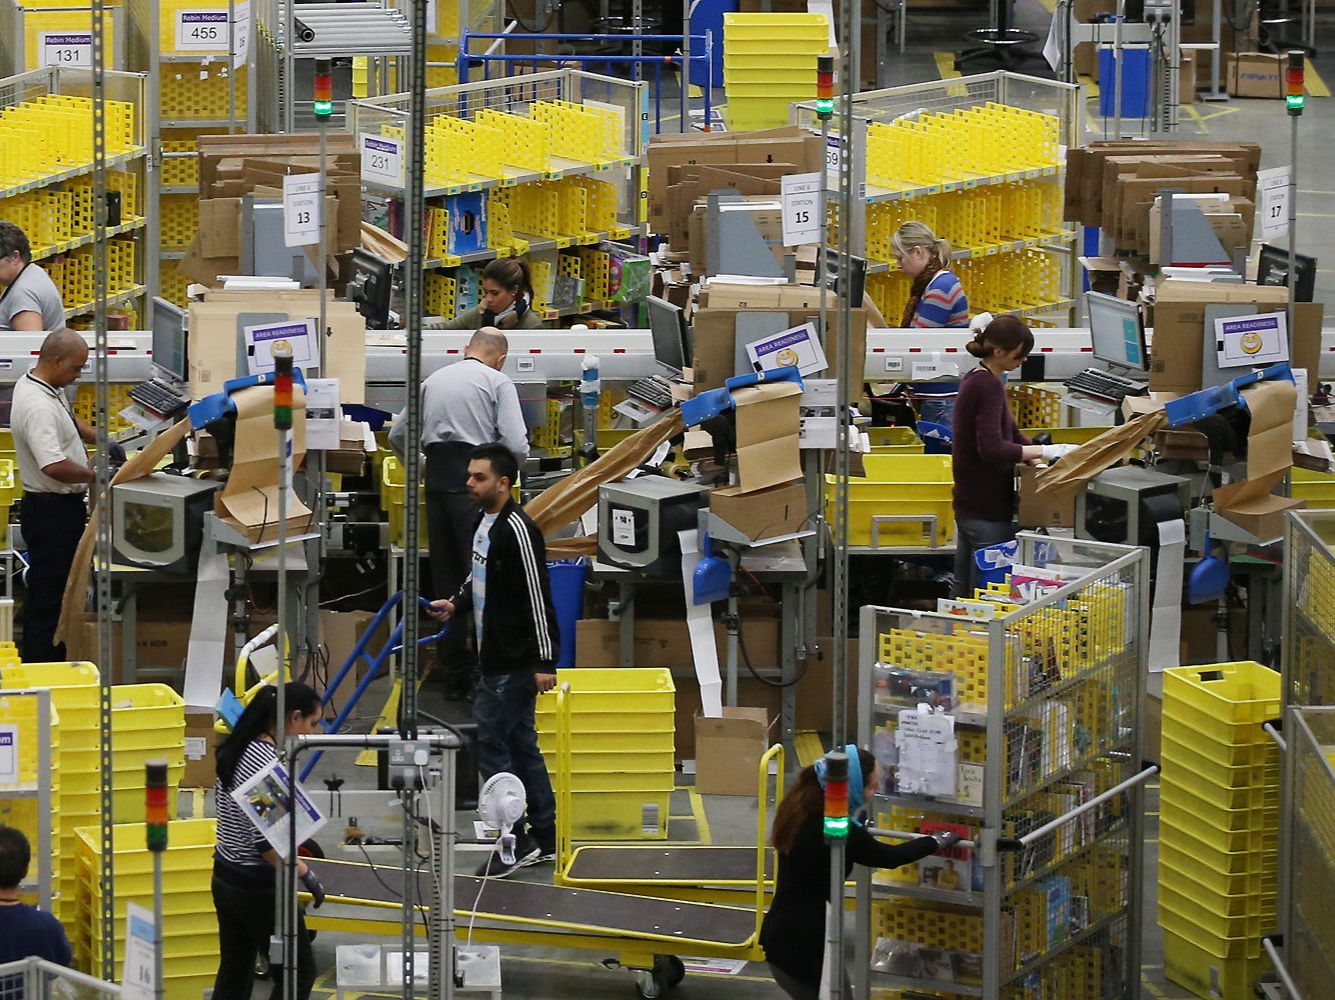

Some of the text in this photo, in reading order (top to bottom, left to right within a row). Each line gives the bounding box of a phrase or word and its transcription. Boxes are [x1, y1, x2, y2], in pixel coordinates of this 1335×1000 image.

[191, 28, 217, 40] 455
[55, 49, 80, 62] 131
[371, 154, 388, 170] 231
[791, 199, 813, 207] STATION
[297, 211, 310, 224] 13
[795, 211, 809, 224] 15
[1271, 205, 1282, 218] 17
[273, 327, 306, 335] READINESS
[1242, 321, 1276, 329] READINESS
[757, 333, 806, 353] AREA READINESS
